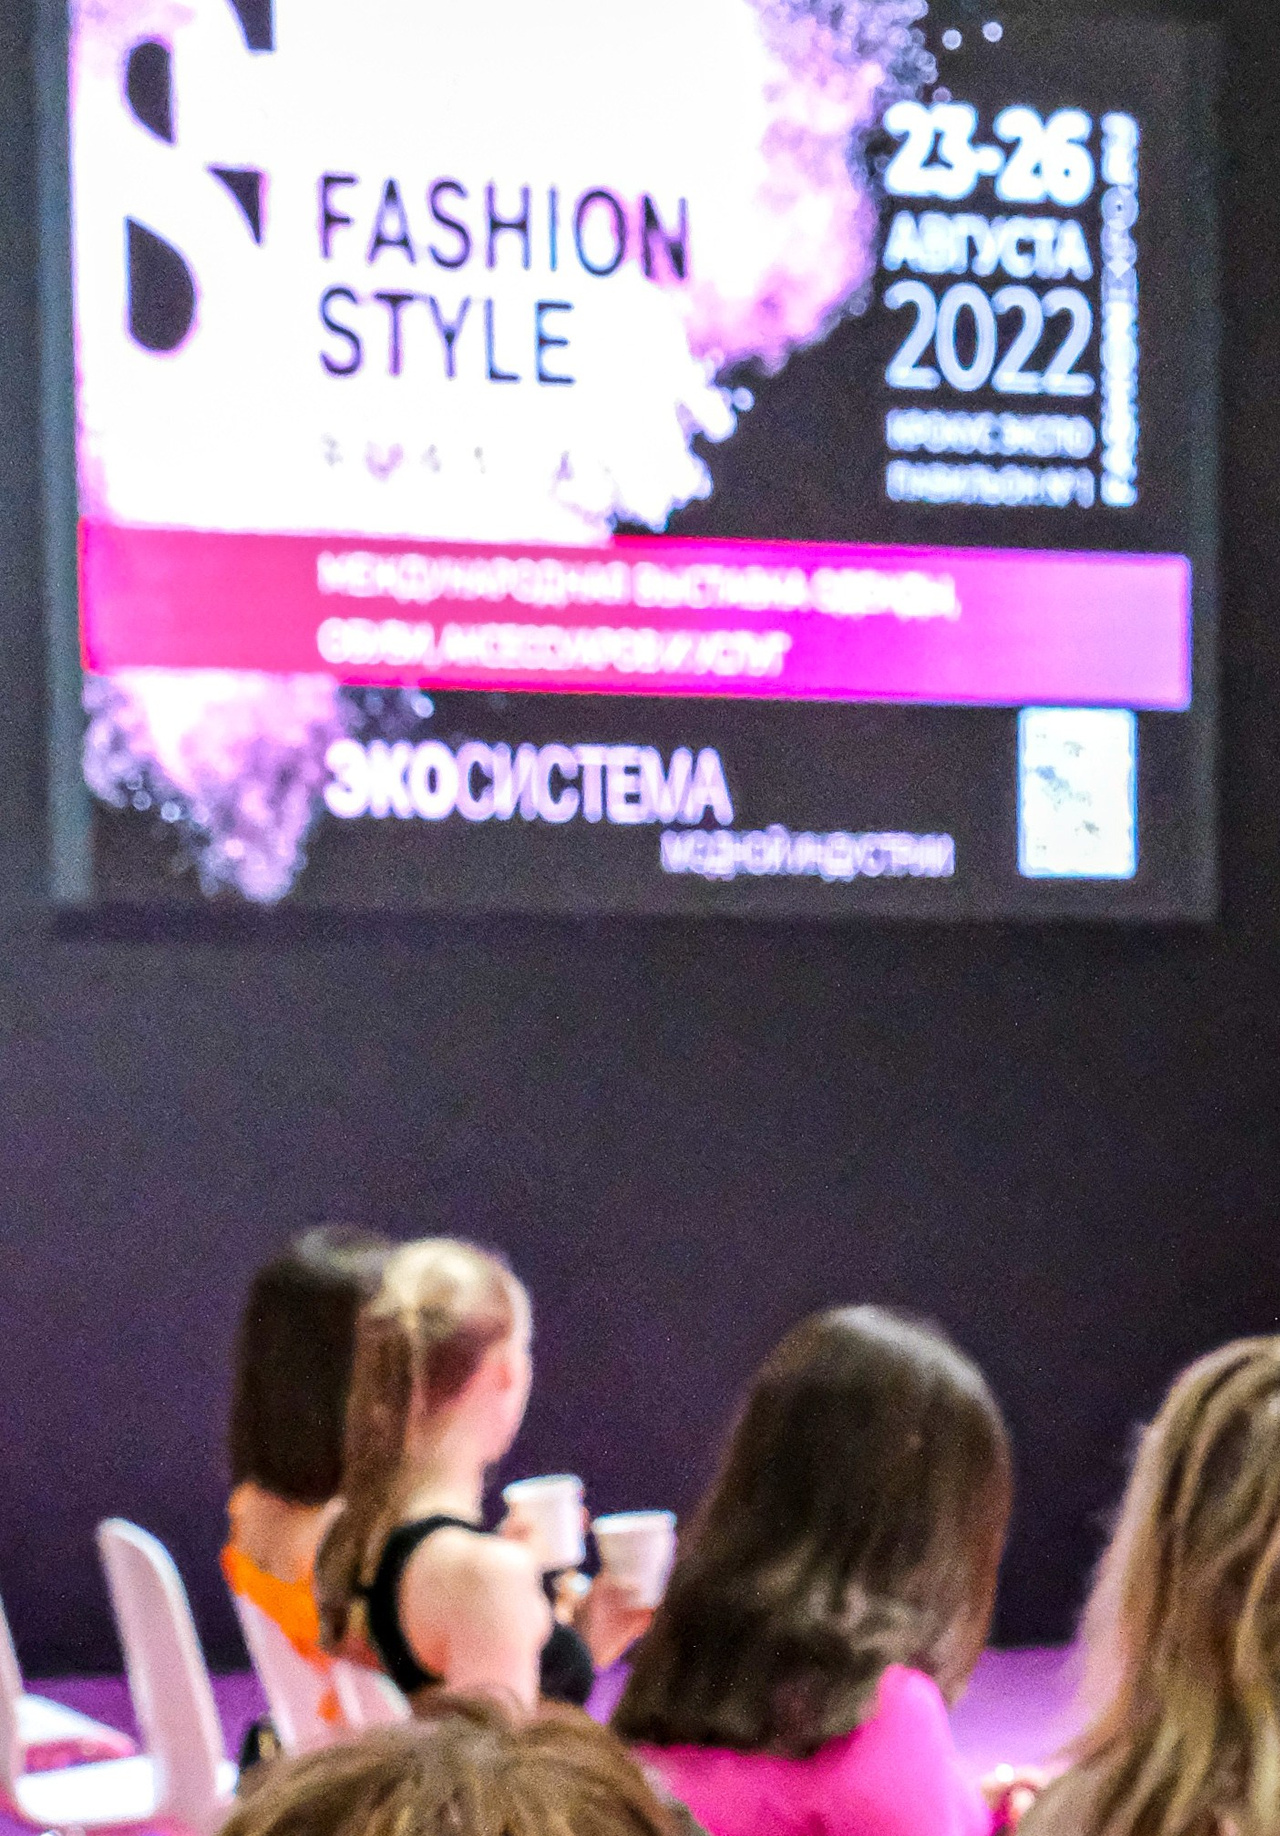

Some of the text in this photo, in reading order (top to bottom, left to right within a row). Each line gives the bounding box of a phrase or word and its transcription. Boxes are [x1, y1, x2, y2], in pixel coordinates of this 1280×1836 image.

[883, 101, 1095, 206] 23-26
[317, 173, 690, 281] FASHION
[884, 210, 1093, 280] АВГУСТА
[318, 284, 576, 387] STYLE
[884, 279, 1095, 396] 2022
[324, 738, 734, 825] ЭКОСИСТЕМА
